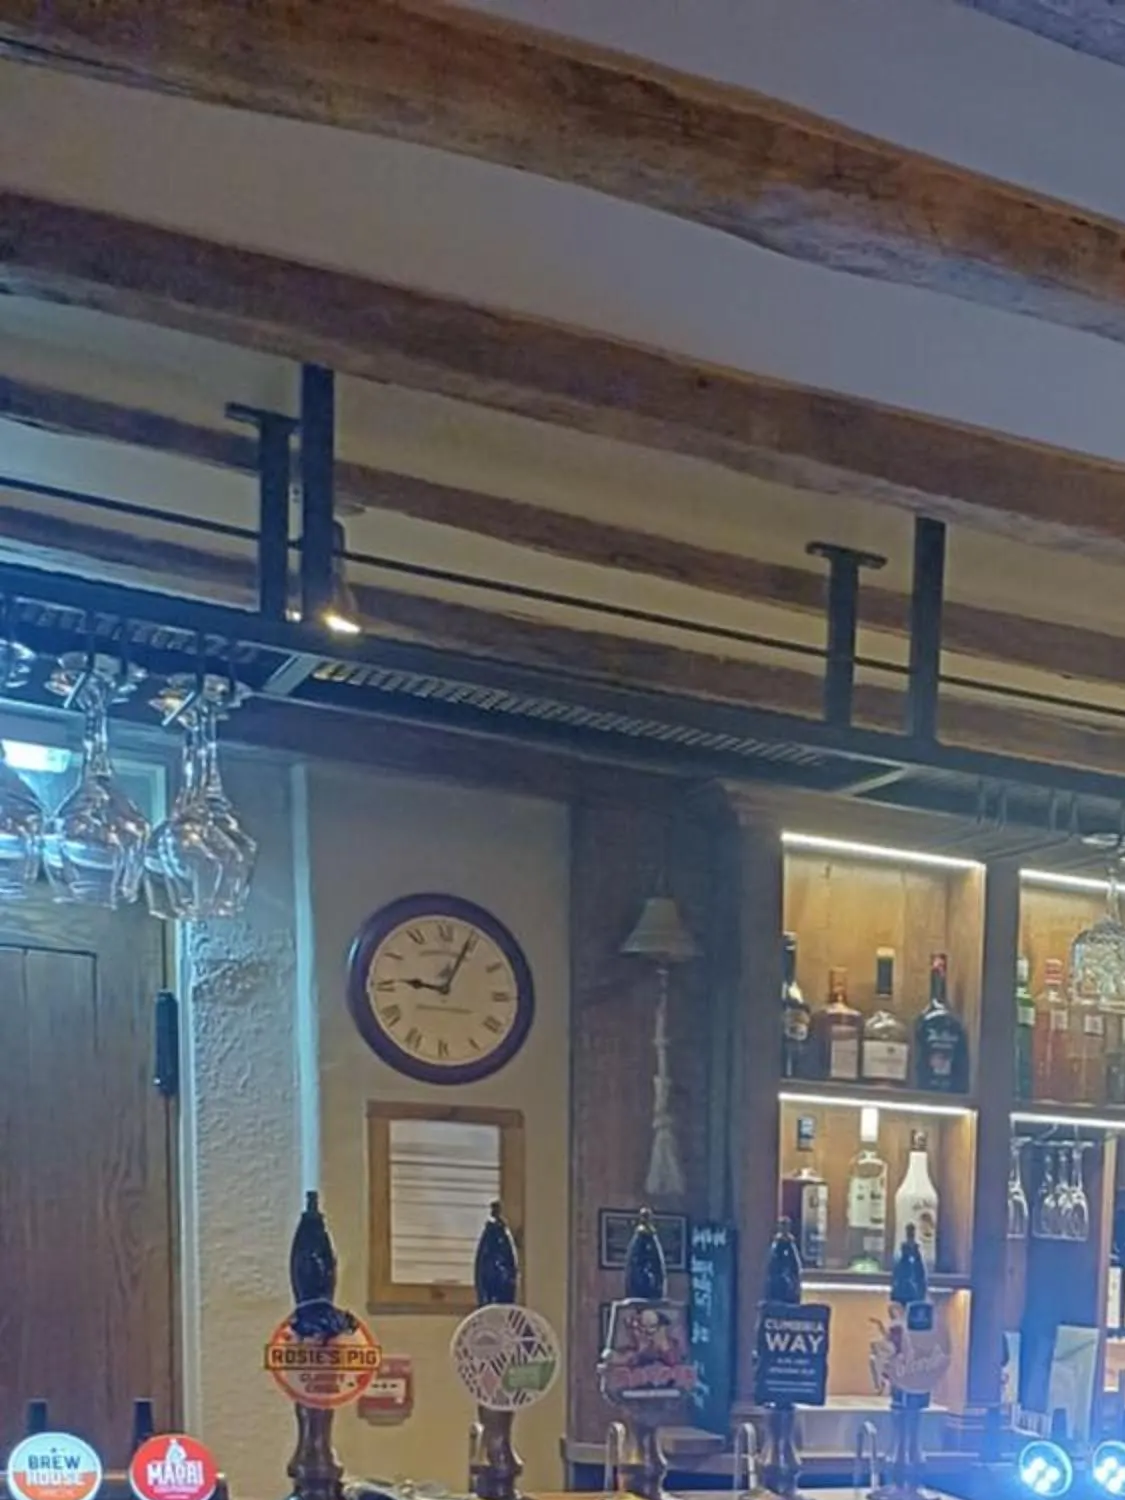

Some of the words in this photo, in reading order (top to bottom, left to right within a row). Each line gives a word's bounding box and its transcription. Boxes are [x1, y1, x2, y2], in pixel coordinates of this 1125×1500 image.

[765, 1332, 824, 1354] WAY
[347, 1350, 378, 1366] PIG
[28, 1455, 81, 1470] BREW
